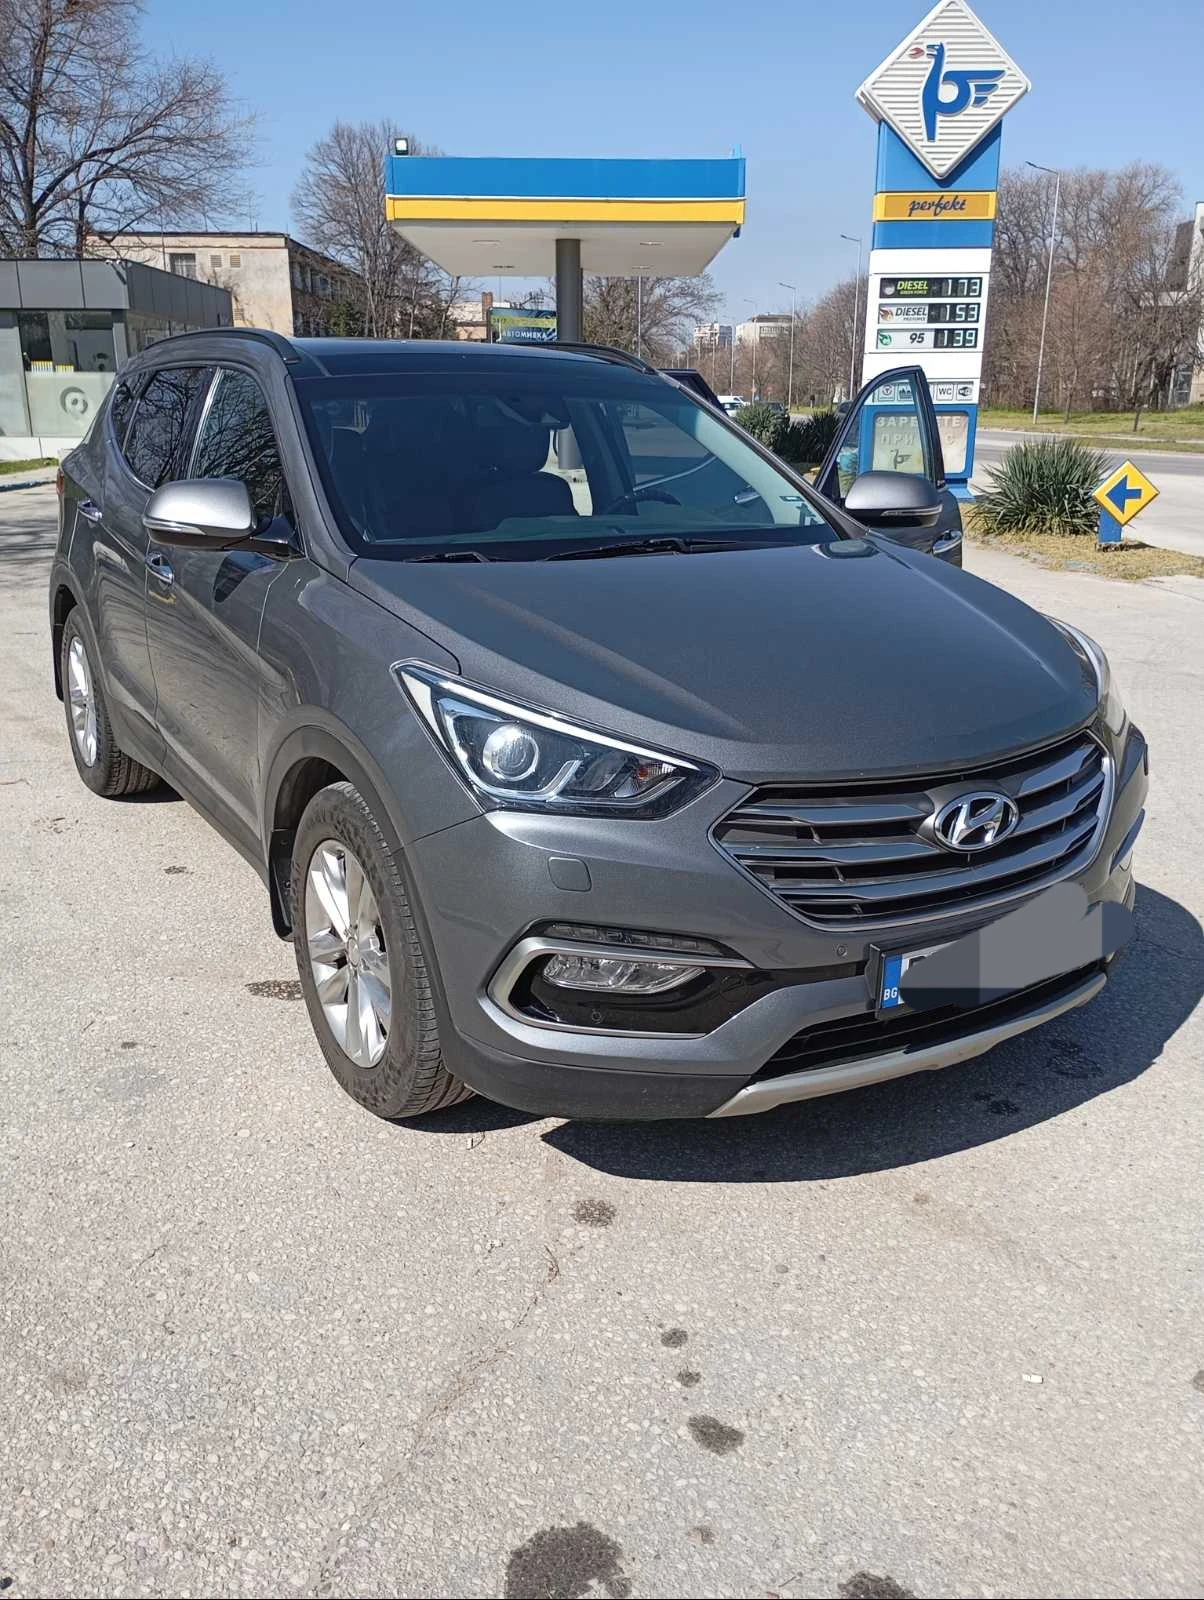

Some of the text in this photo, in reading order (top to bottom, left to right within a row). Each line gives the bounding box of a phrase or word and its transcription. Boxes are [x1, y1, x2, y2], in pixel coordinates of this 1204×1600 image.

[908, 195, 967, 217] perfekt
[897, 280, 928, 289] DIESEL
[895, 307, 927, 316] DIESEL
[910, 333, 925, 344] 95
[884, 987, 898, 1000] BG
